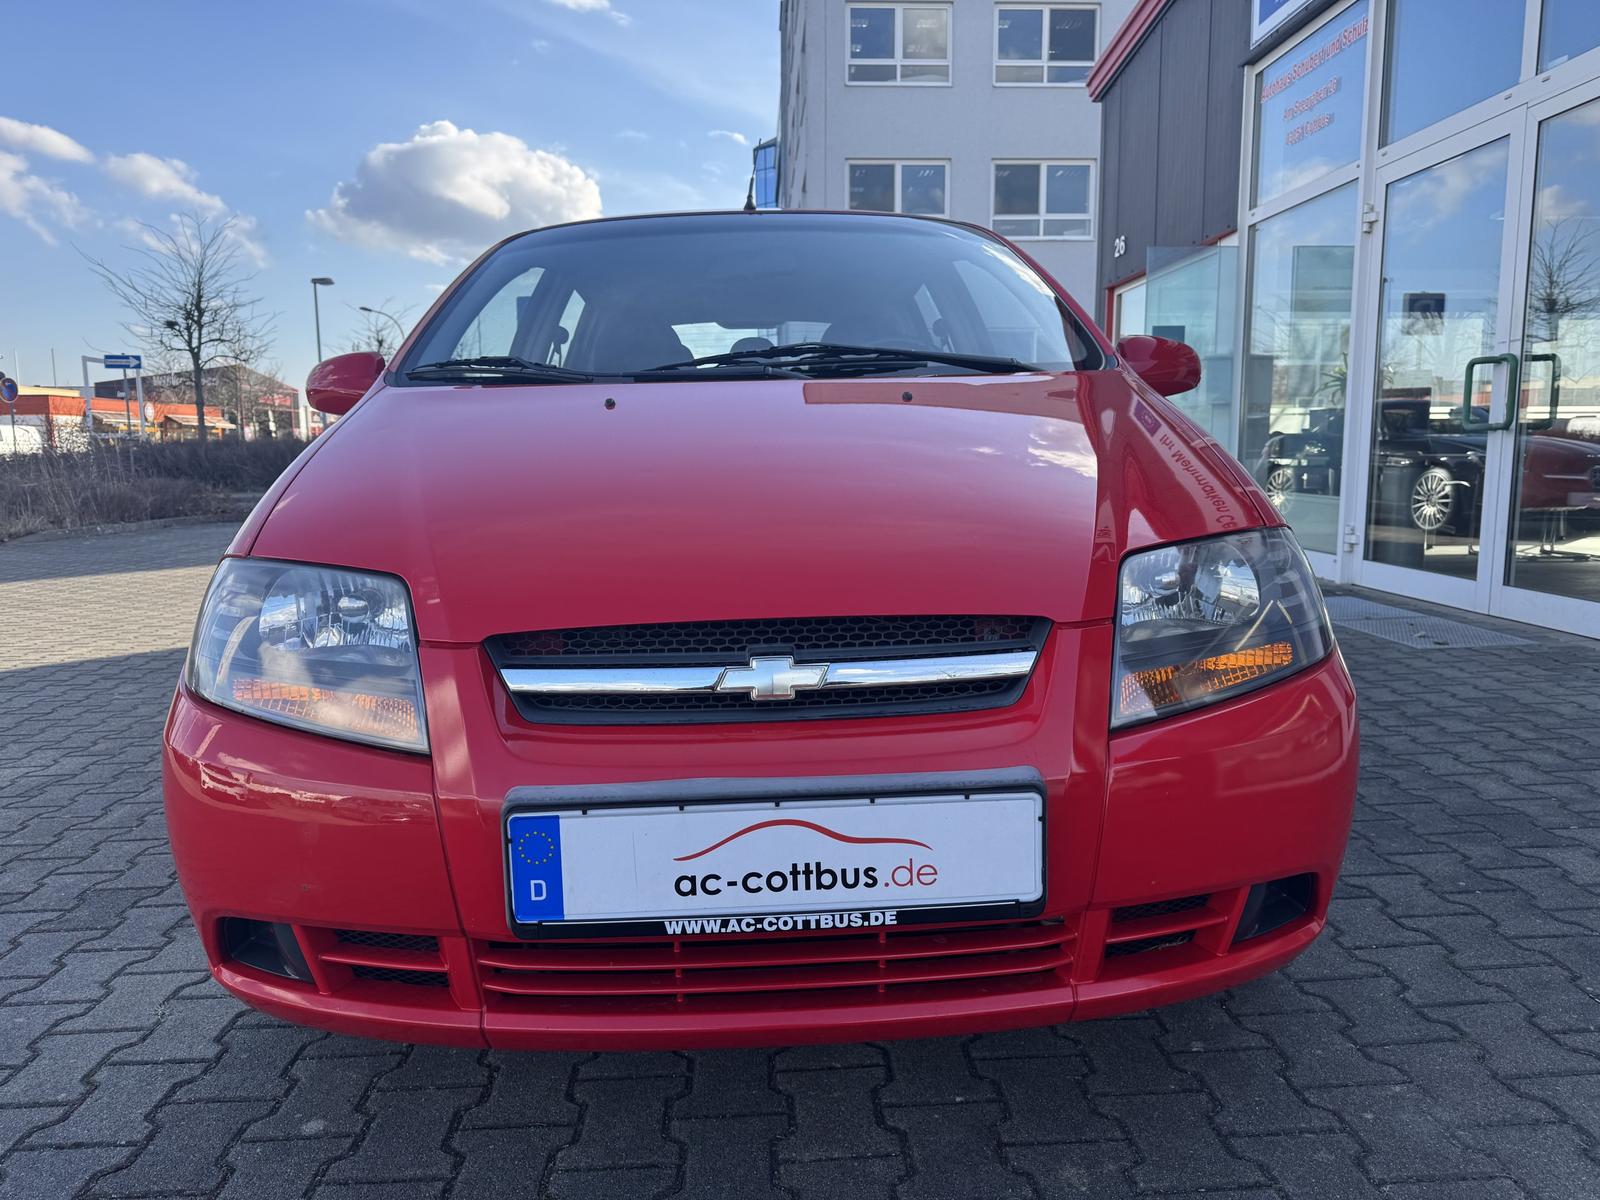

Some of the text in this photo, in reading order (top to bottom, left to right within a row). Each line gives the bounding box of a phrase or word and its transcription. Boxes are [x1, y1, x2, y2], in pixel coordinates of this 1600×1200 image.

[1325, 33, 1343, 60] und
[1114, 235, 1126, 258] 26
[674, 858, 938, 897] ac-cottbus.de
[530, 879, 547, 901] D
[664, 911, 898, 935] WWW.AC-COTTBUS.DE
